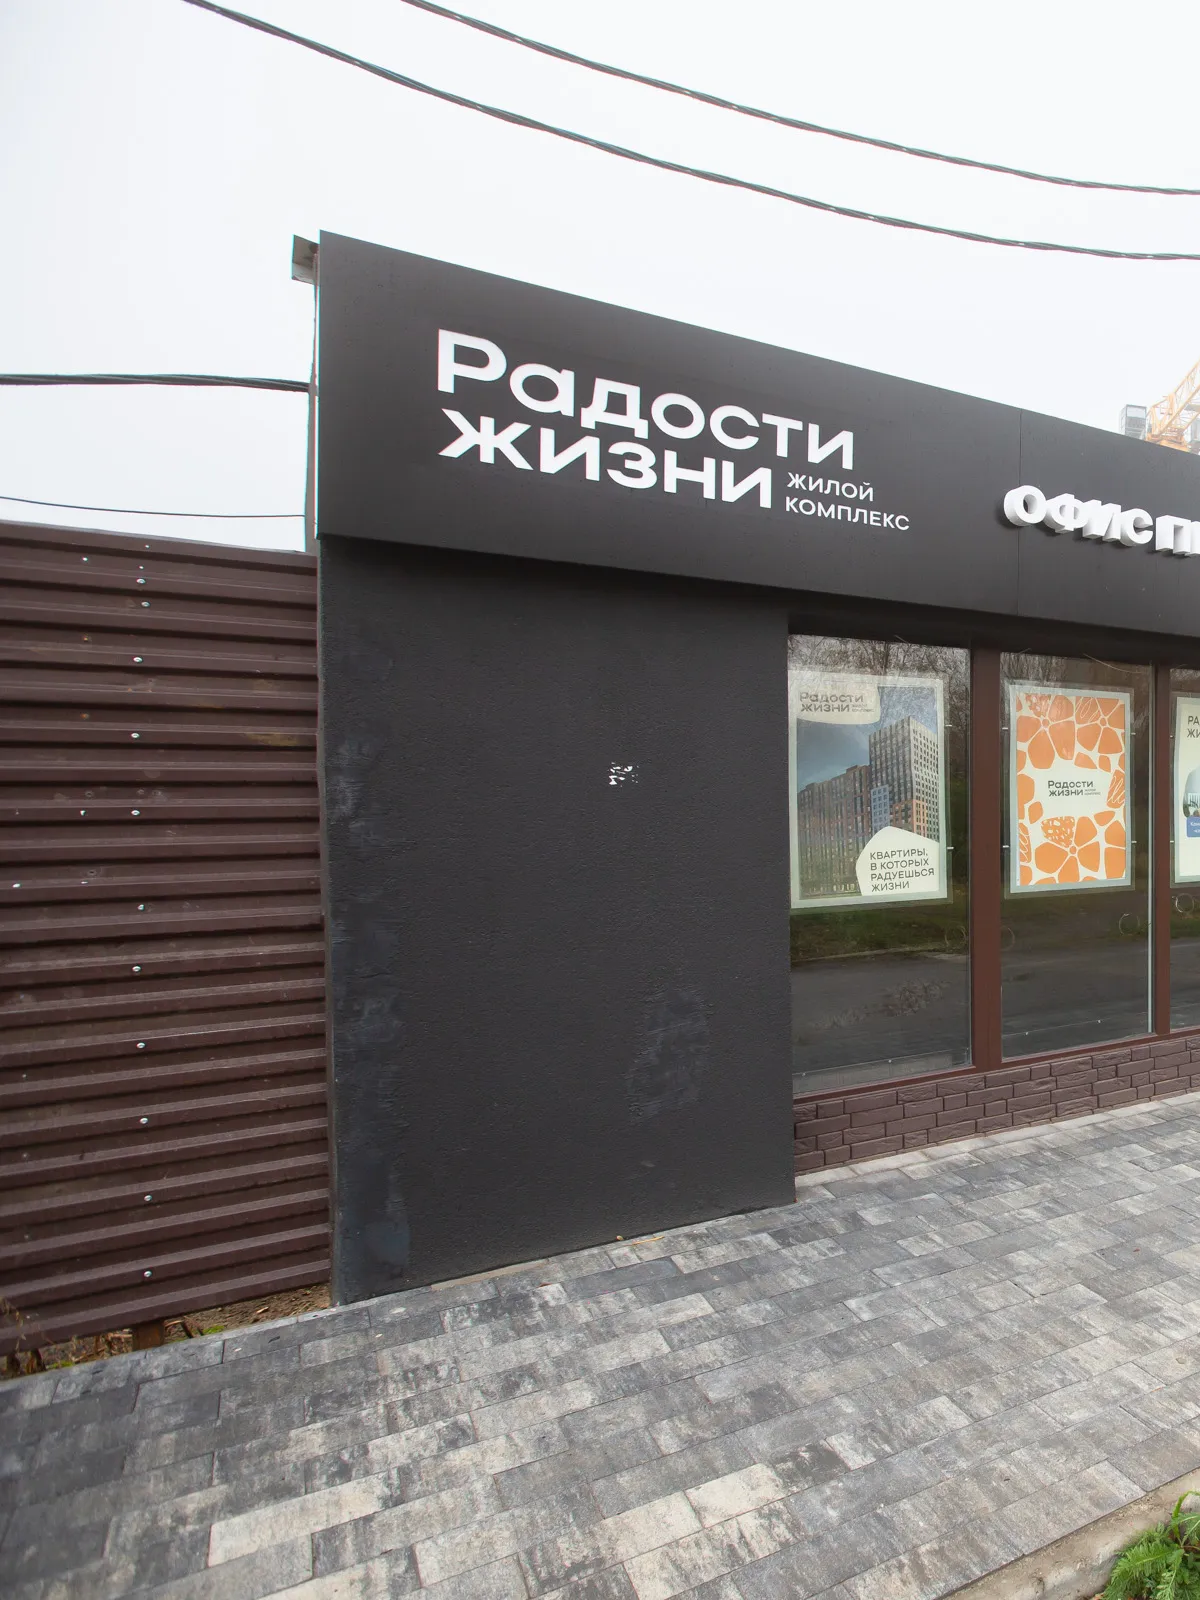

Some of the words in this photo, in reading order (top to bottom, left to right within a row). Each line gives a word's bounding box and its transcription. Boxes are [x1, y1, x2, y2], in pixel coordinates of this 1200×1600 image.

[437, 329, 854, 470] Радости
[438, 408, 772, 509] жизни
[1003, 485, 1154, 548] ОФИС
[799, 692, 864, 703] Радости
[800, 703, 850, 713] жизни
[1047, 780, 1094, 789] Радости
[1048, 789, 1084, 797] жизни
[870, 862, 877, 871] В
[880, 858, 930, 870] КОТОРЫХ
[870, 867, 935, 882] РАДУЕШЬСЯ
[871, 881, 910, 893] ЖИЗНИ
